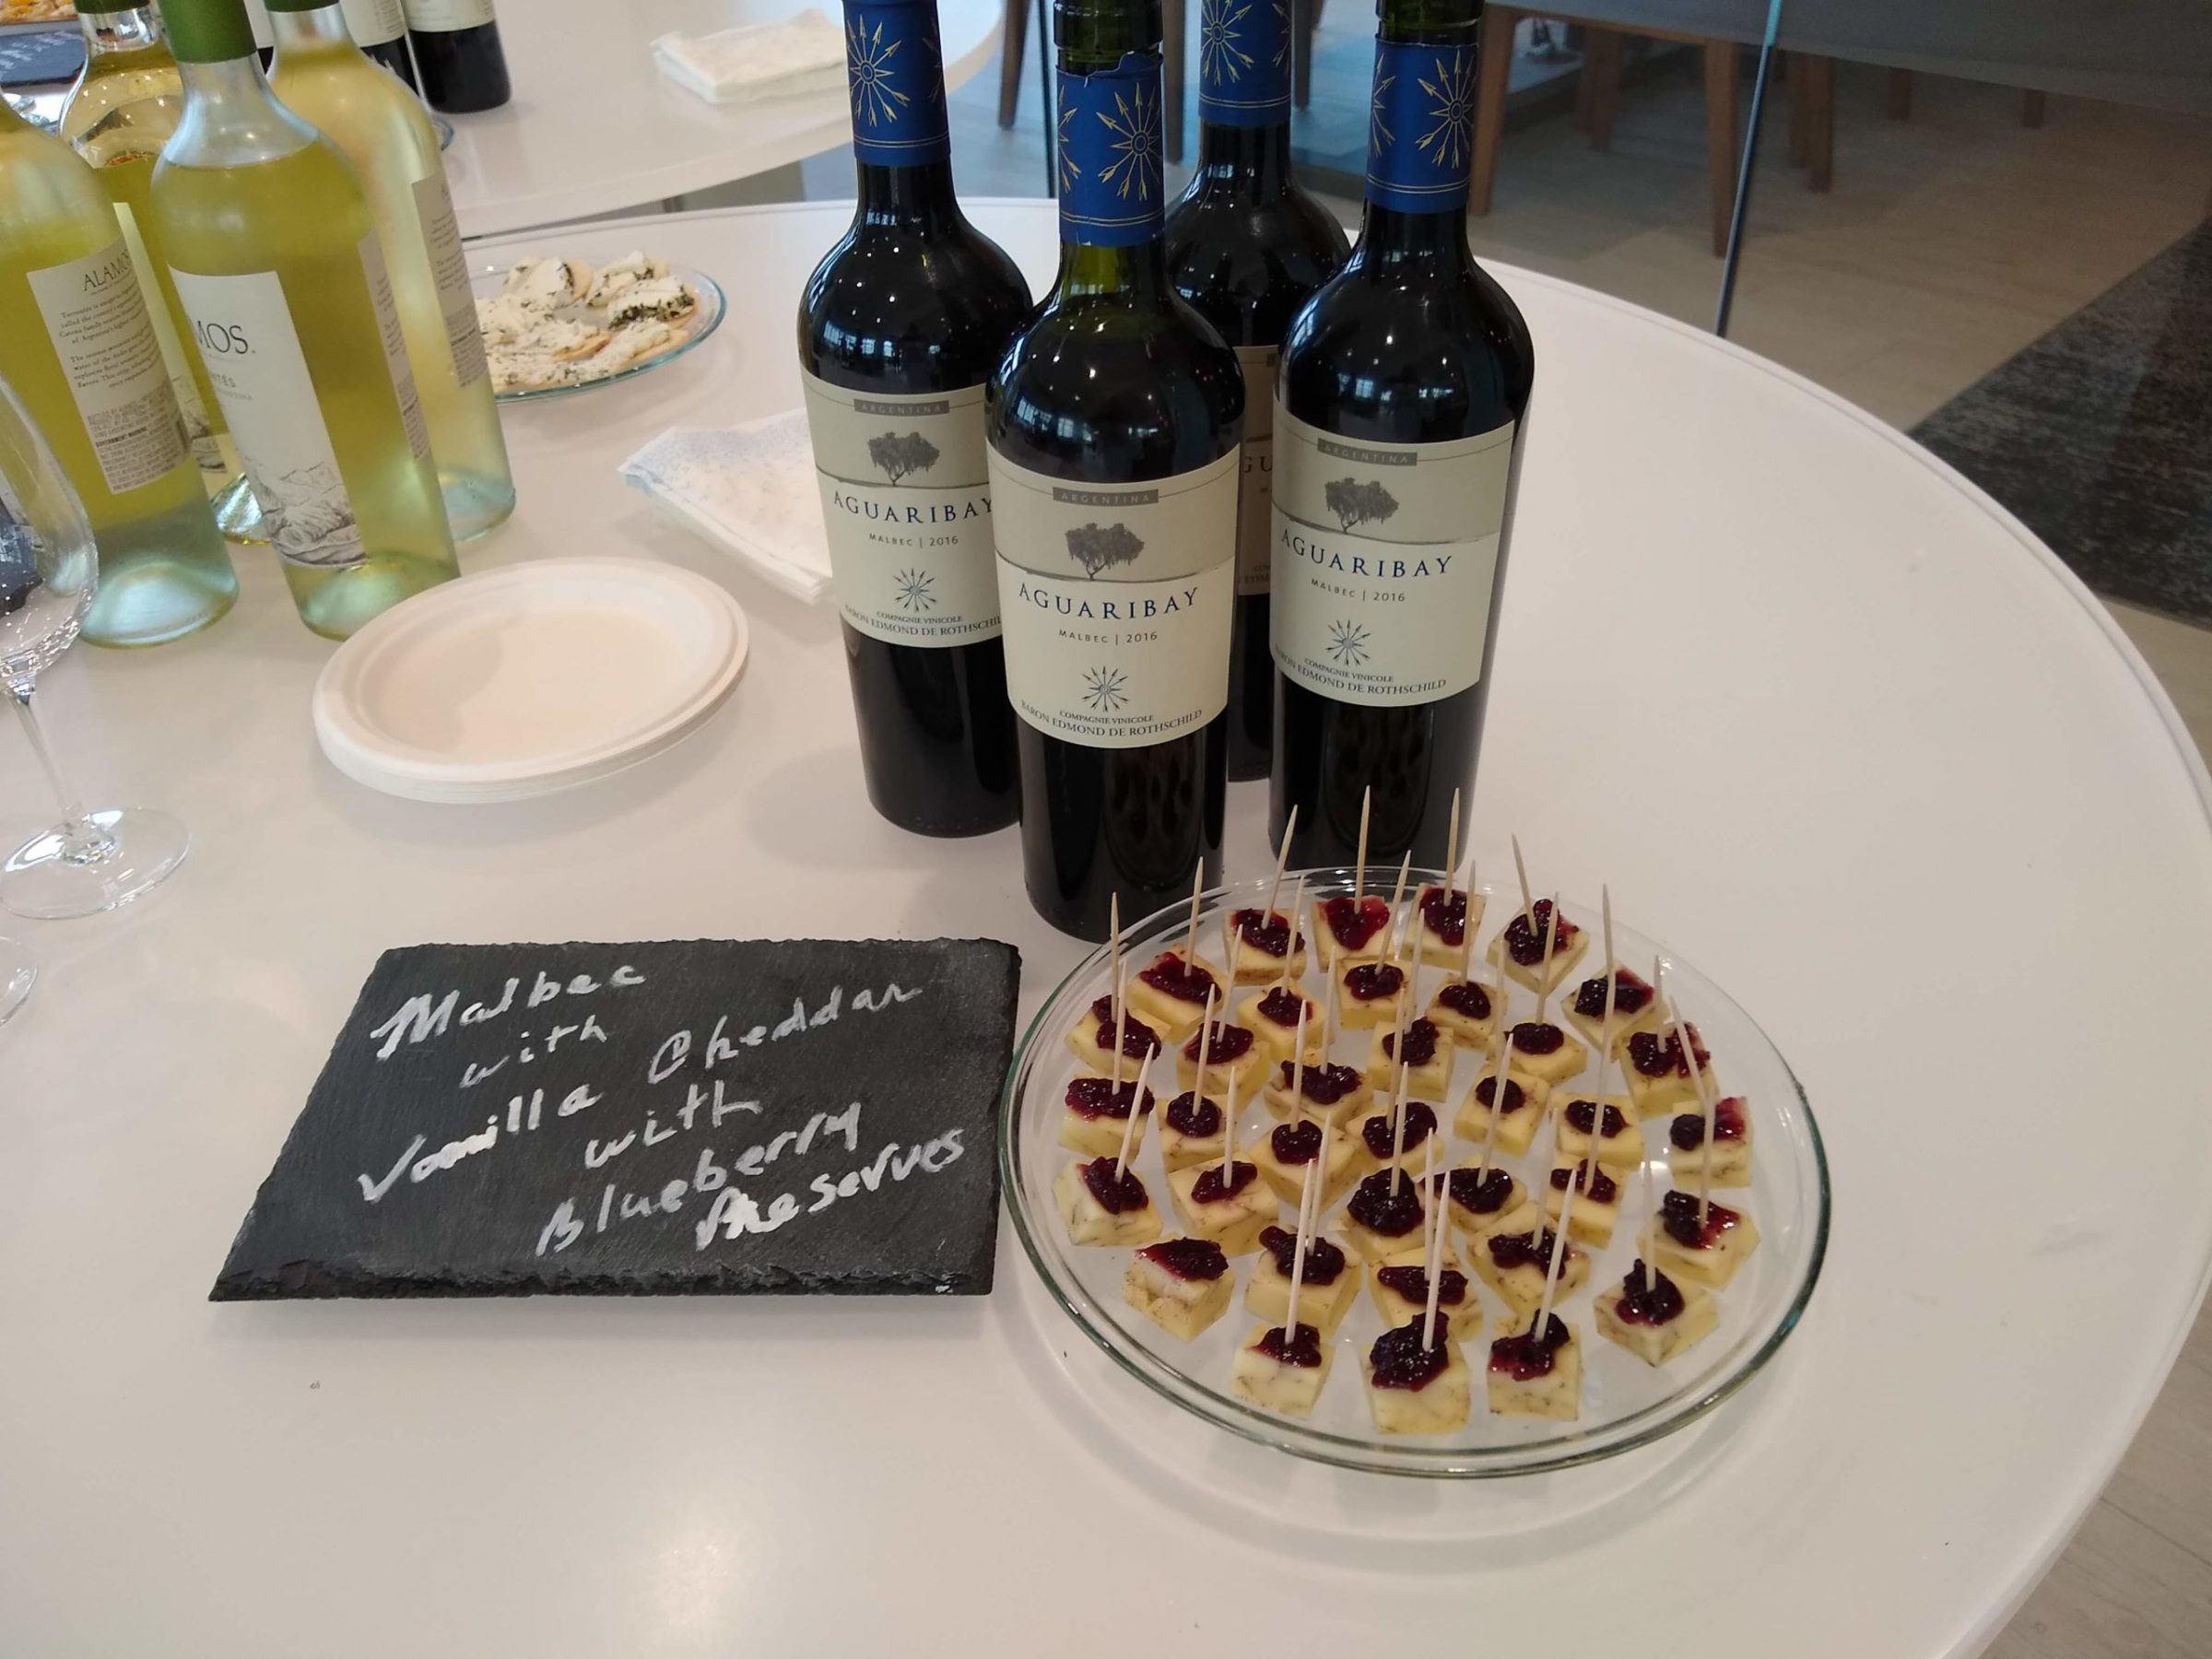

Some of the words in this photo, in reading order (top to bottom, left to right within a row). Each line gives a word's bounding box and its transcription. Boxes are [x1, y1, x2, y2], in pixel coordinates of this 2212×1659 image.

[861, 403, 941, 414] ARGENTINA
[1324, 445, 1408, 464] ARGENTINA
[834, 490, 993, 524] AGUARIBAY
[1062, 492, 1150, 504] ARGENTINA
[869, 533, 912, 547] MALBEC
[929, 535, 959, 547] 2016
[1281, 528, 1453, 578] AGUARIBAY
[1018, 582, 1198, 619] AGUARIBAY
[1311, 578, 1356, 597] MALBEC
[1373, 593, 1406, 602] 2016
[871, 618, 919, 636] EDMOND
[922, 628, 937, 636] DE
[940, 617, 1002, 636] ROTHSCHIL
[877, 611, 921, 624] COMPAGNIE
[923, 615, 962, 625] VINICOLE
[1059, 629, 1108, 643] MALBEC
[1126, 631, 1158, 643] 2016
[1297, 664, 1345, 689] EDMOND
[1347, 682, 1364, 693] DE
[1368, 678, 1447, 695] ROTHSCHILD
[1304, 658, 1349, 678] COMPAGNIE
[1352, 673, 1394, 683] VINICOLE
[1021, 700, 1050, 724] BARON
[1052, 717, 1105, 736] EDMOND
[1109, 728, 1126, 736] DE
[1129, 709, 1203, 736] ROTHSCHILD
[1060, 710, 1108, 724] COMPAGNIE
[1112, 714, 1154, 724] VINICOLE
[370, 965, 646, 1061] Malbec
[647, 982, 923, 1084] Cheddar
[459, 1014, 607, 1088] with
[585, 1079, 763, 1169] with
[535, 1101, 862, 1257] Blueberry
